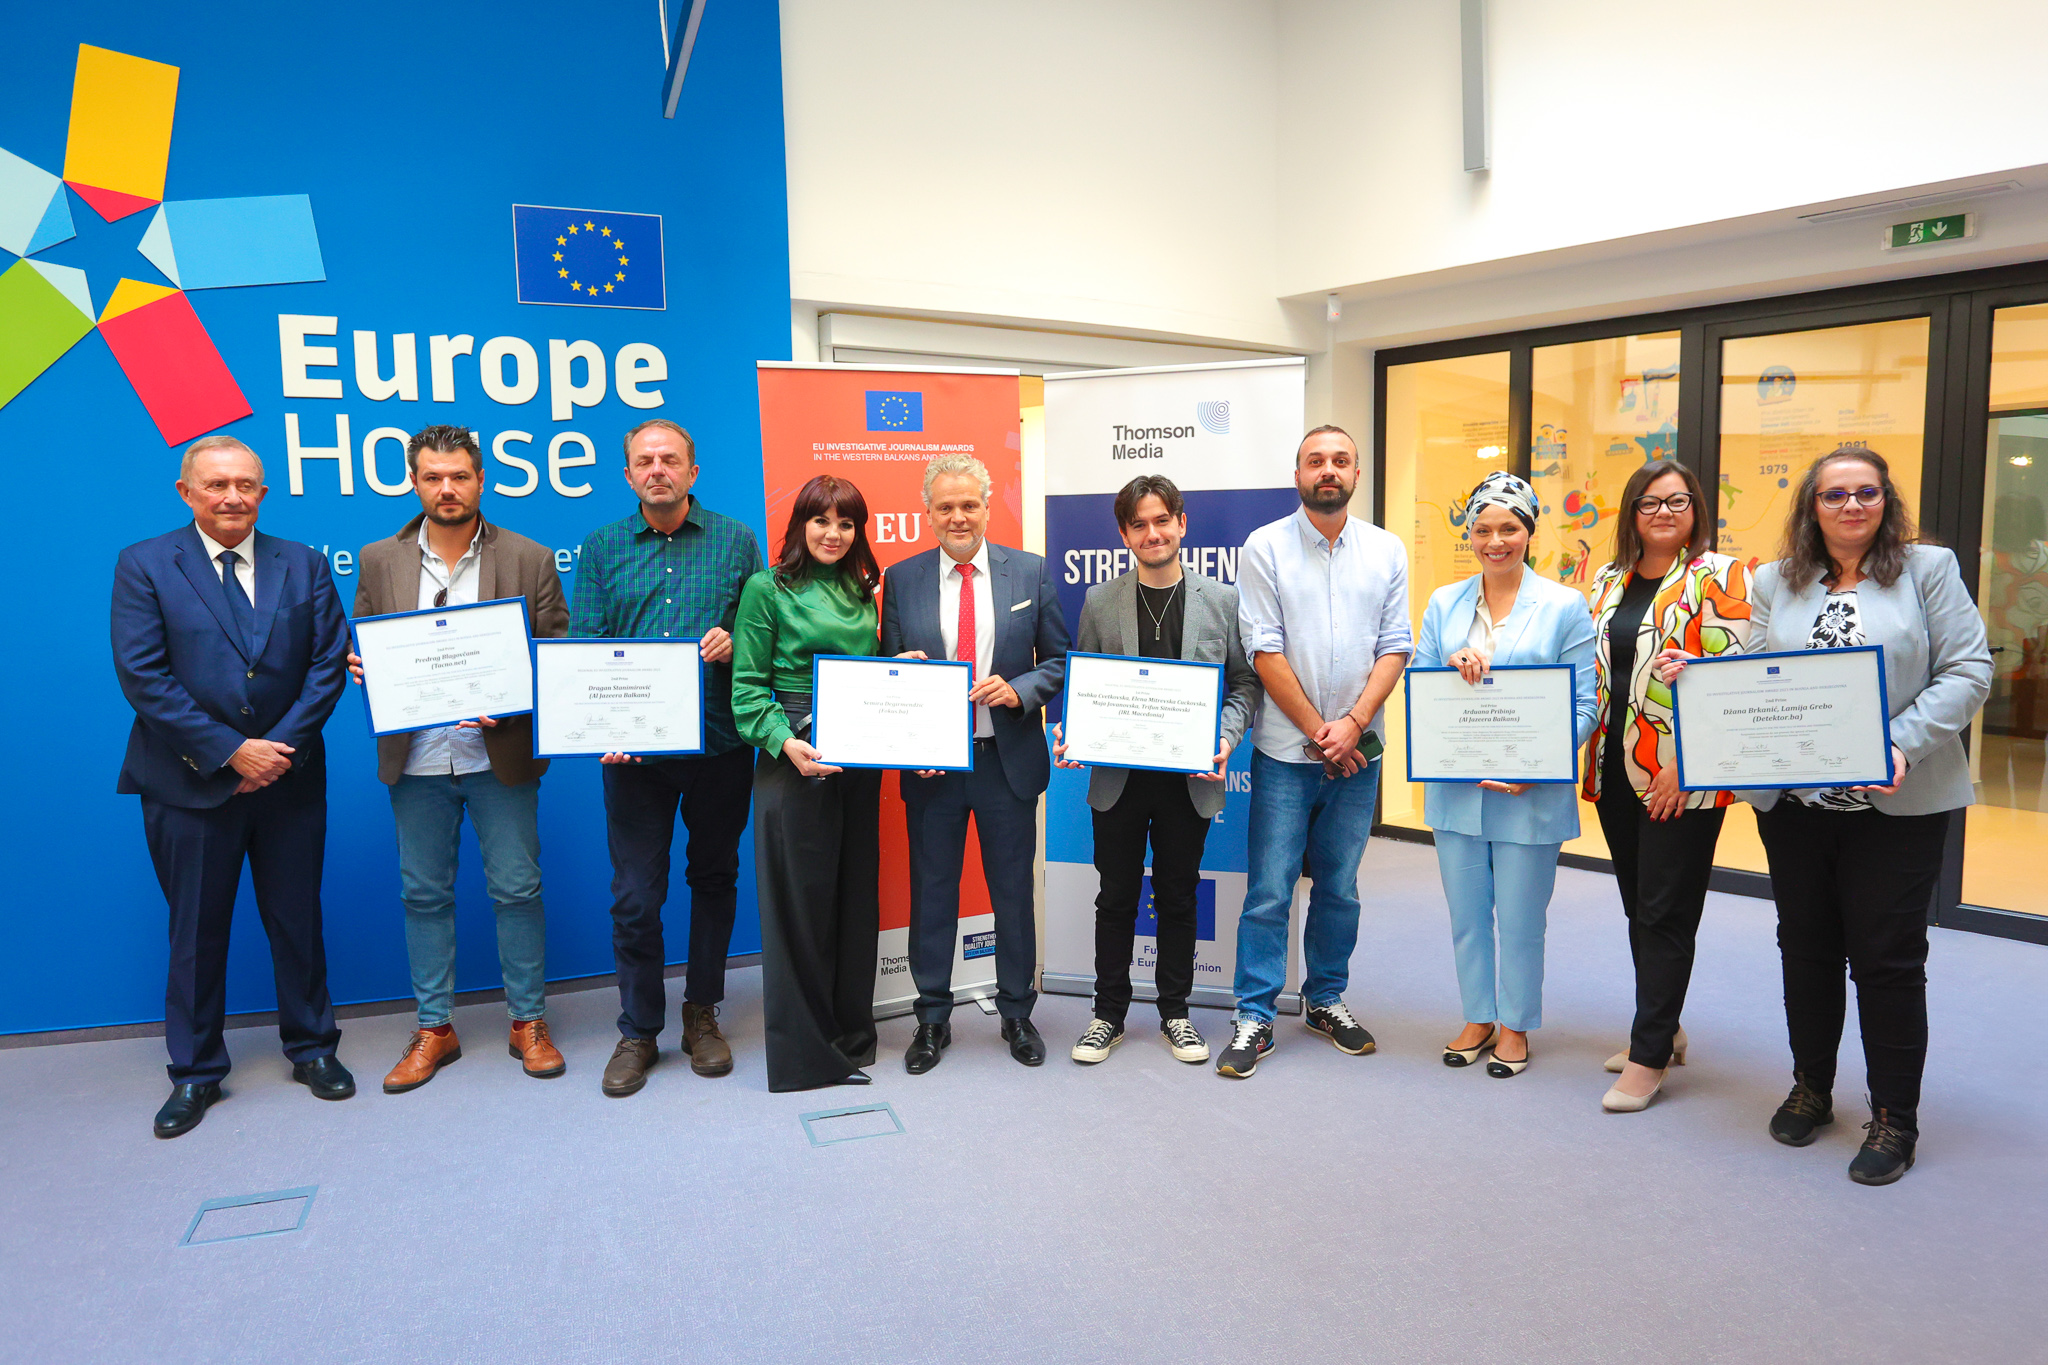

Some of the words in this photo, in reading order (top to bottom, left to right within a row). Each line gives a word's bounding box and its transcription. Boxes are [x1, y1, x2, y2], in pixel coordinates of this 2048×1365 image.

[278, 314, 668, 421] Europe
[1113, 425, 1195, 441] Thomson
[812, 443, 825, 451] EU
[826, 443, 887, 451] INVESTIGATIVE
[888, 443, 939, 452] JOURNALISM
[940, 444, 974, 452] AWARDS
[1112, 443, 1163, 460] Media
[285, 412, 596, 498] Hose
[813, 453, 822, 461] IN
[824, 453, 841, 461] THE
[842, 453, 882, 461] WESTERN
[883, 454, 920, 462] BALKANS
[1759, 464, 1788, 475] 1979
[874, 513, 922, 543] EU
[1748, 706, 1779, 714] Brkanić,
[1752, 714, 1803, 723] (Detektor.ba)
[881, 955, 910, 966] Thoms
[881, 965, 907, 976] Media
